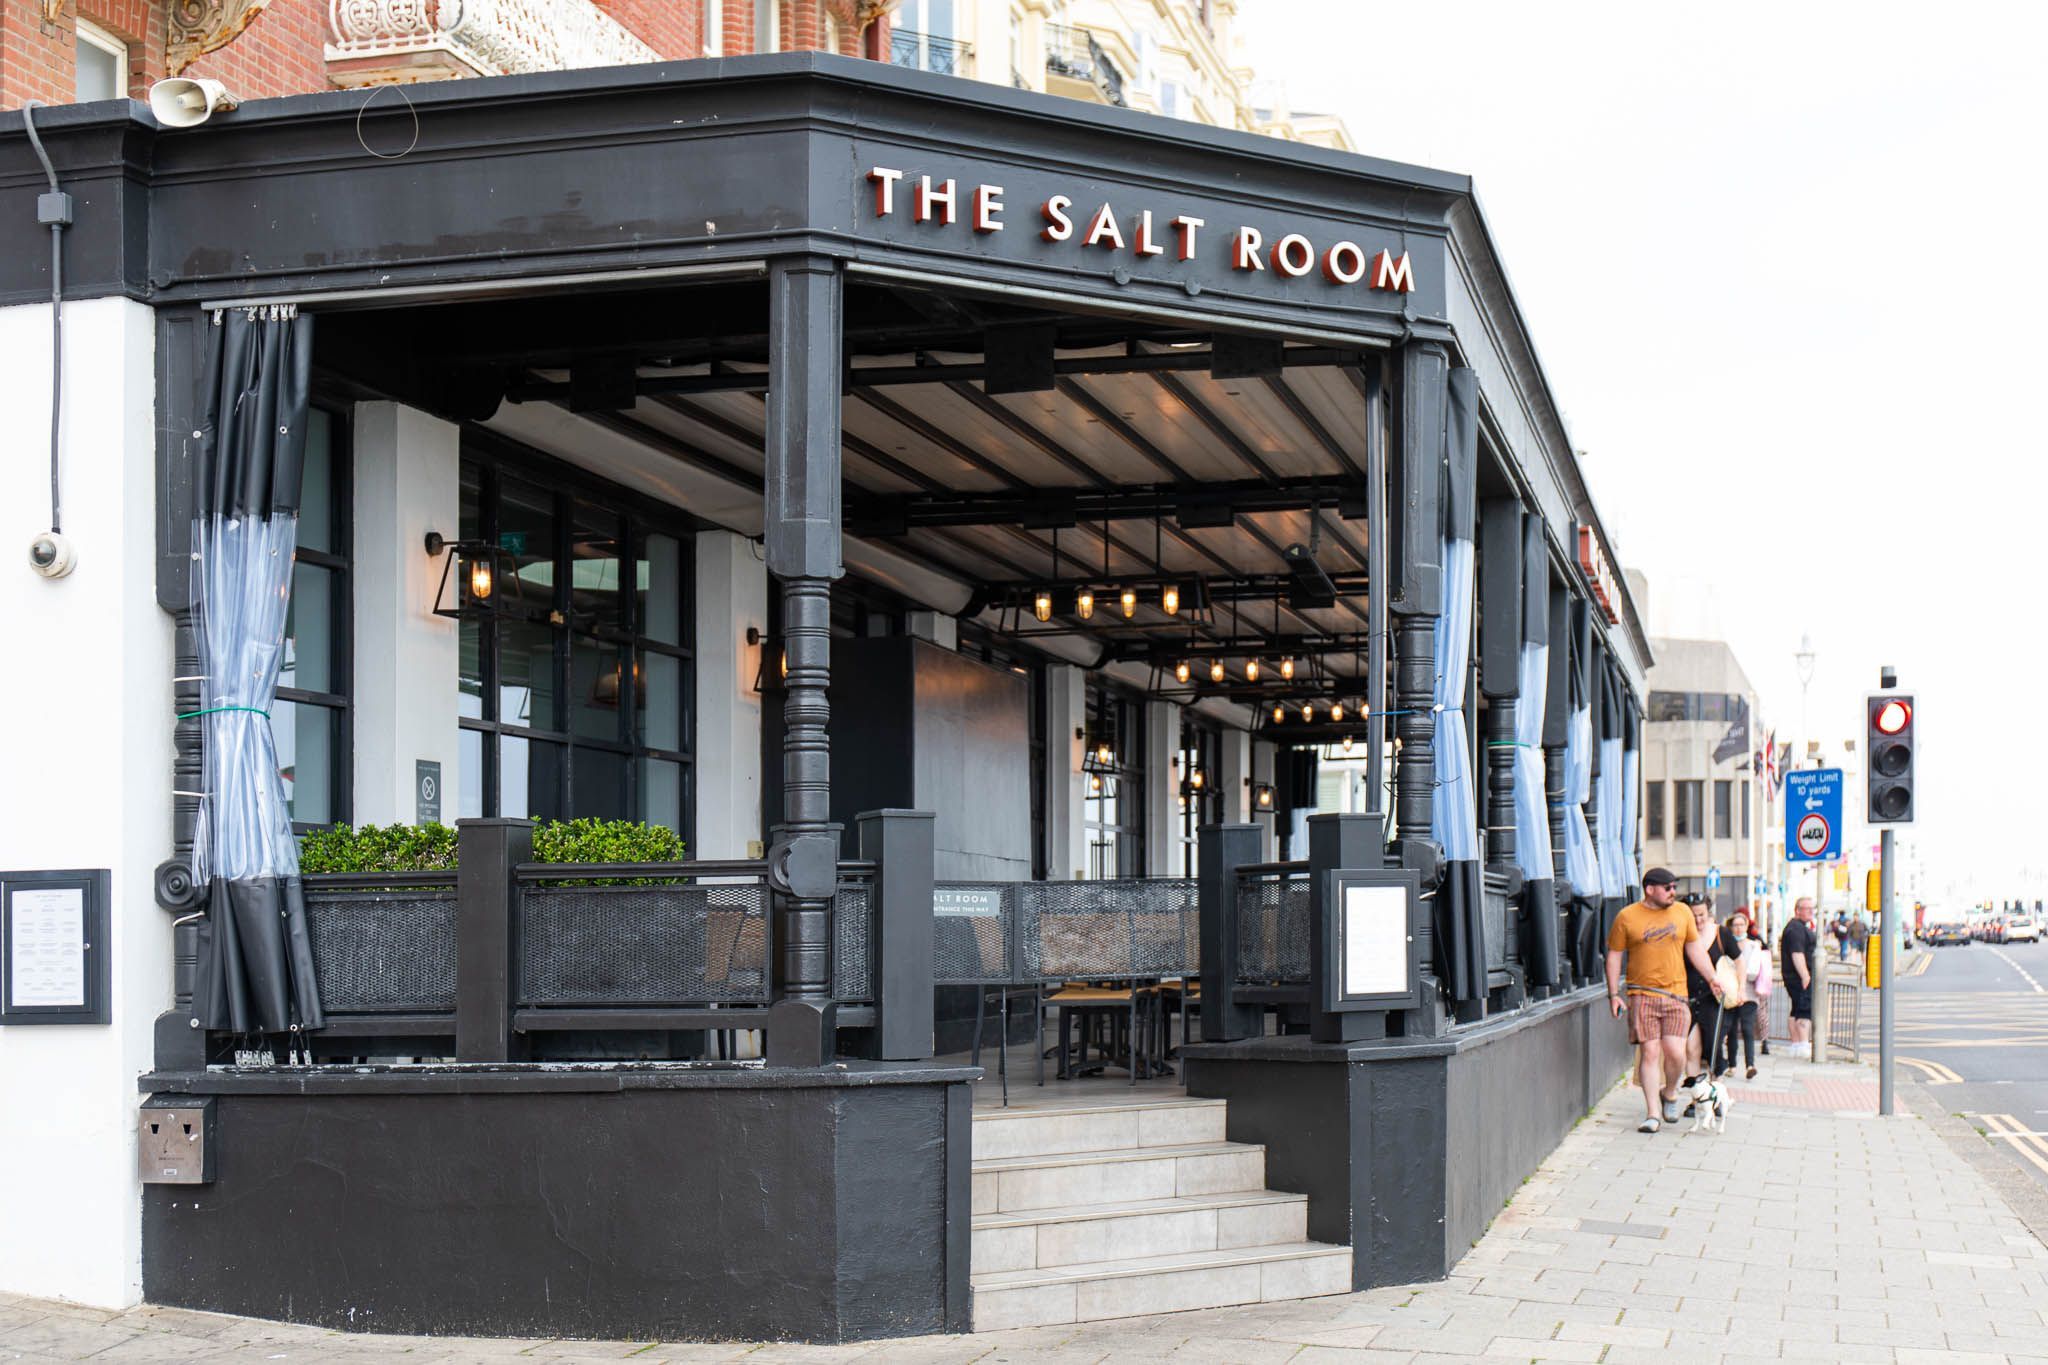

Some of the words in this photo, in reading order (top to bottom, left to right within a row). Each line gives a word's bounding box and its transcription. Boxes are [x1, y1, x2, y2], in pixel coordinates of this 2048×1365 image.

[867, 166, 1005, 234] THE
[1040, 194, 1205, 262] SALT
[1232, 225, 1416, 293] ROOM
[1791, 774, 1816, 785] Weight
[1819, 772, 1839, 783] Limit
[1798, 786, 1806, 796] 10
[1809, 785, 1831, 797] yards
[933, 895, 952, 903] ALT
[955, 895, 988, 903] ROOM
